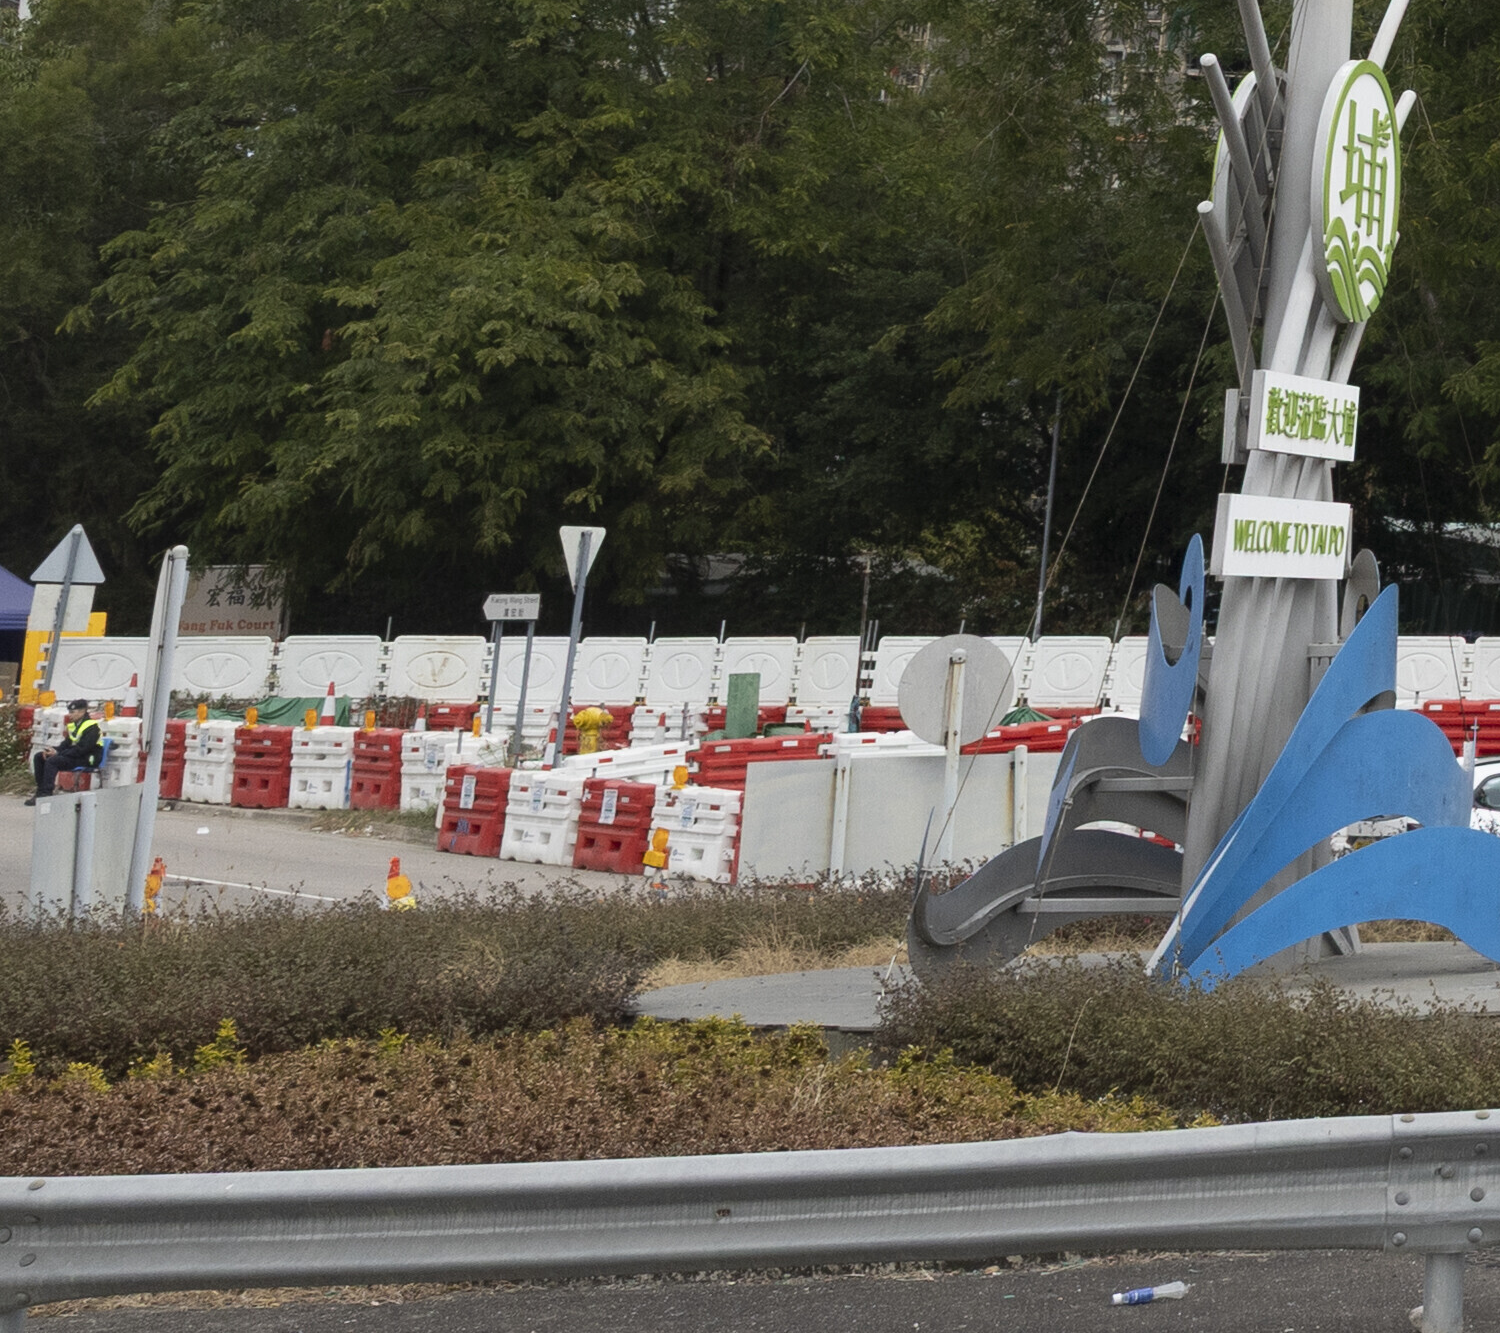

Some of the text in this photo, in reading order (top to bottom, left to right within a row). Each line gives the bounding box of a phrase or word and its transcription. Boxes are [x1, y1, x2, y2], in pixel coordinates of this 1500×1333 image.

[1340, 100, 1391, 251] 埔
[1233, 519, 1345, 557] WELCOME TO TAI PO
[210, 620, 232, 631] Fuk
[237, 619, 275, 631] Court
